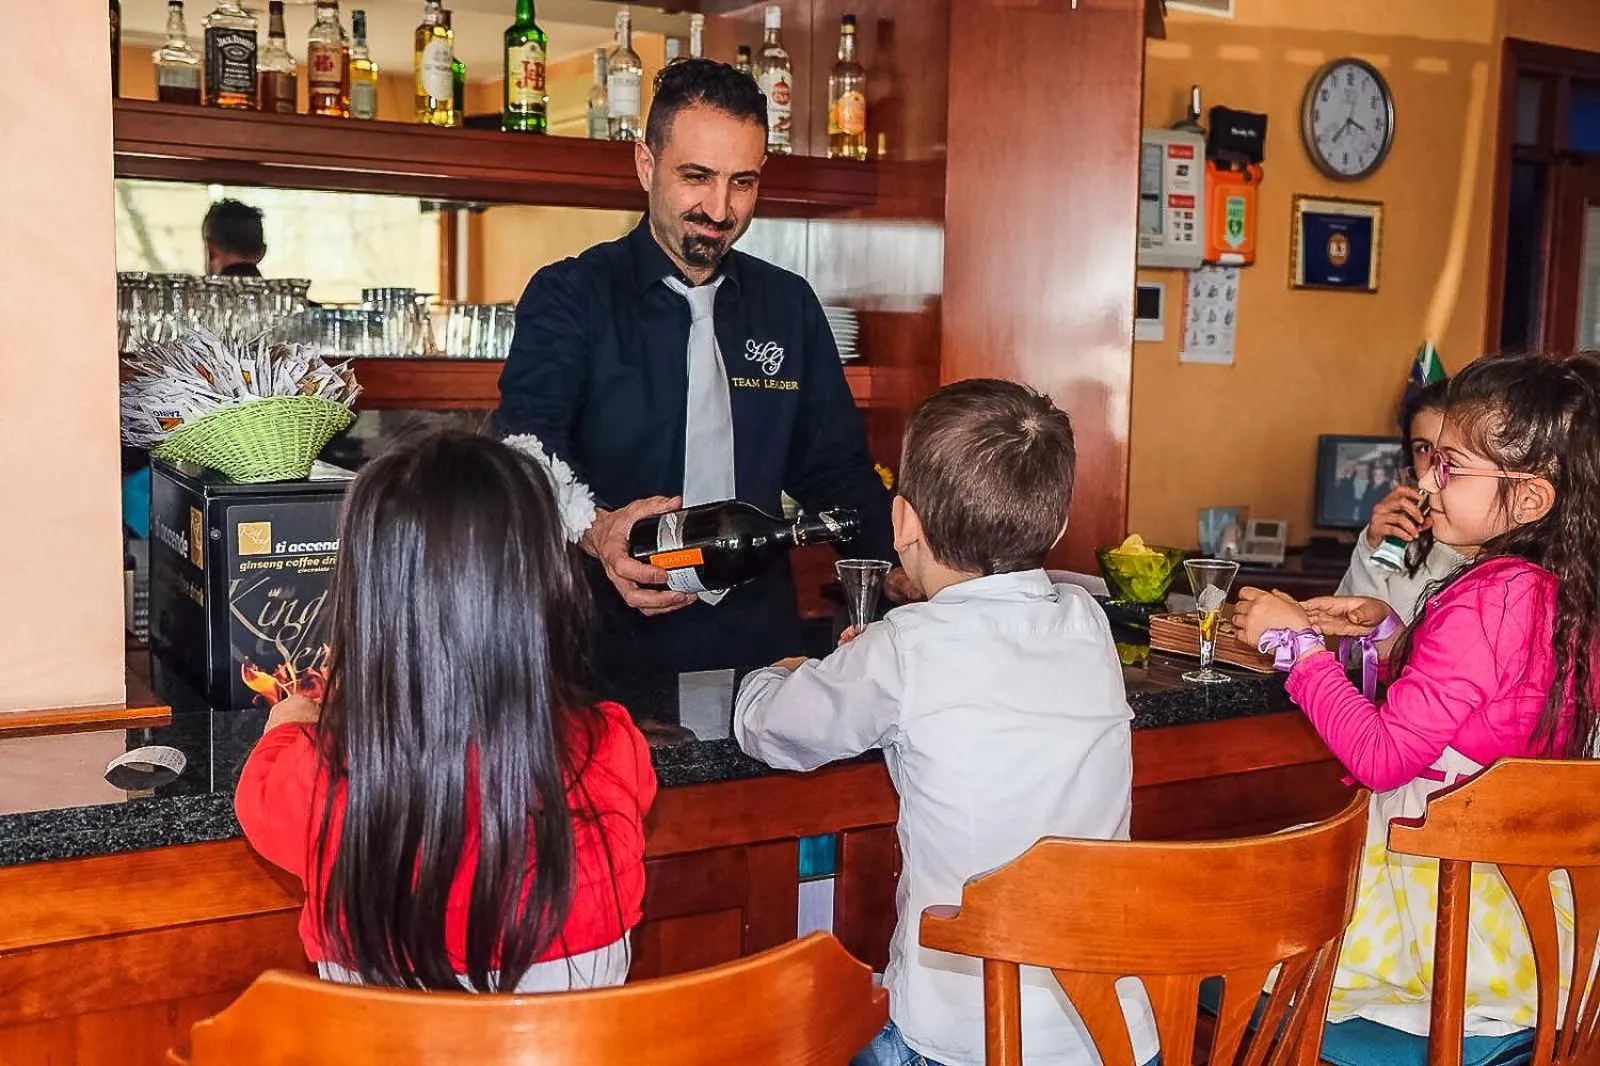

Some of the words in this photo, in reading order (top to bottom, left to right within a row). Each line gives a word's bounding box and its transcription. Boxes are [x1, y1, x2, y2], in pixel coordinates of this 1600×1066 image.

[731, 377, 760, 388] TEAM
[764, 379, 799, 390] LEADER
[275, 540, 287, 553] ti
[288, 538, 340, 552] accend
[239, 560, 283, 572] ginseng
[285, 556, 319, 568] coffee
[321, 555, 337, 565] dri
[230, 577, 328, 660] King
